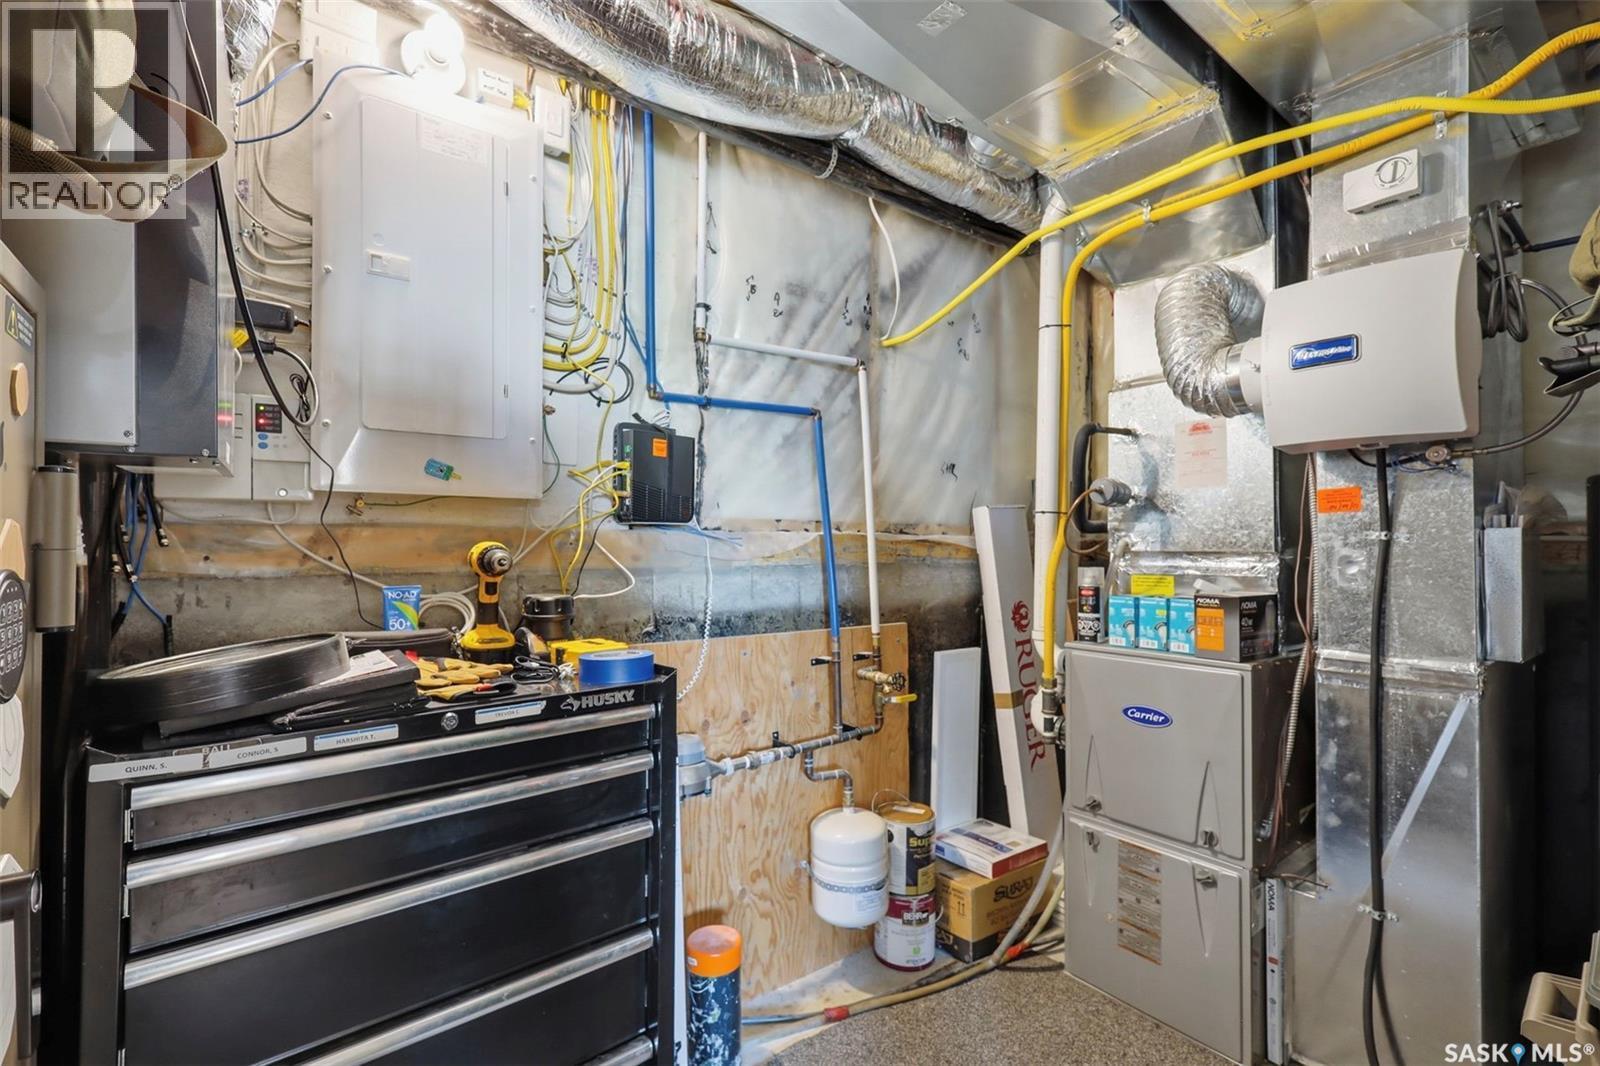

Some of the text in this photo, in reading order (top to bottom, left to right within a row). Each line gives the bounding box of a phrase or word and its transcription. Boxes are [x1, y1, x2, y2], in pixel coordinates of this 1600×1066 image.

[581, 690, 635, 708] HUSKY
[1015, 638, 1046, 773] RUGER
[1127, 708, 1165, 722] Carrier
[125, 763, 157, 773] QUINN,
